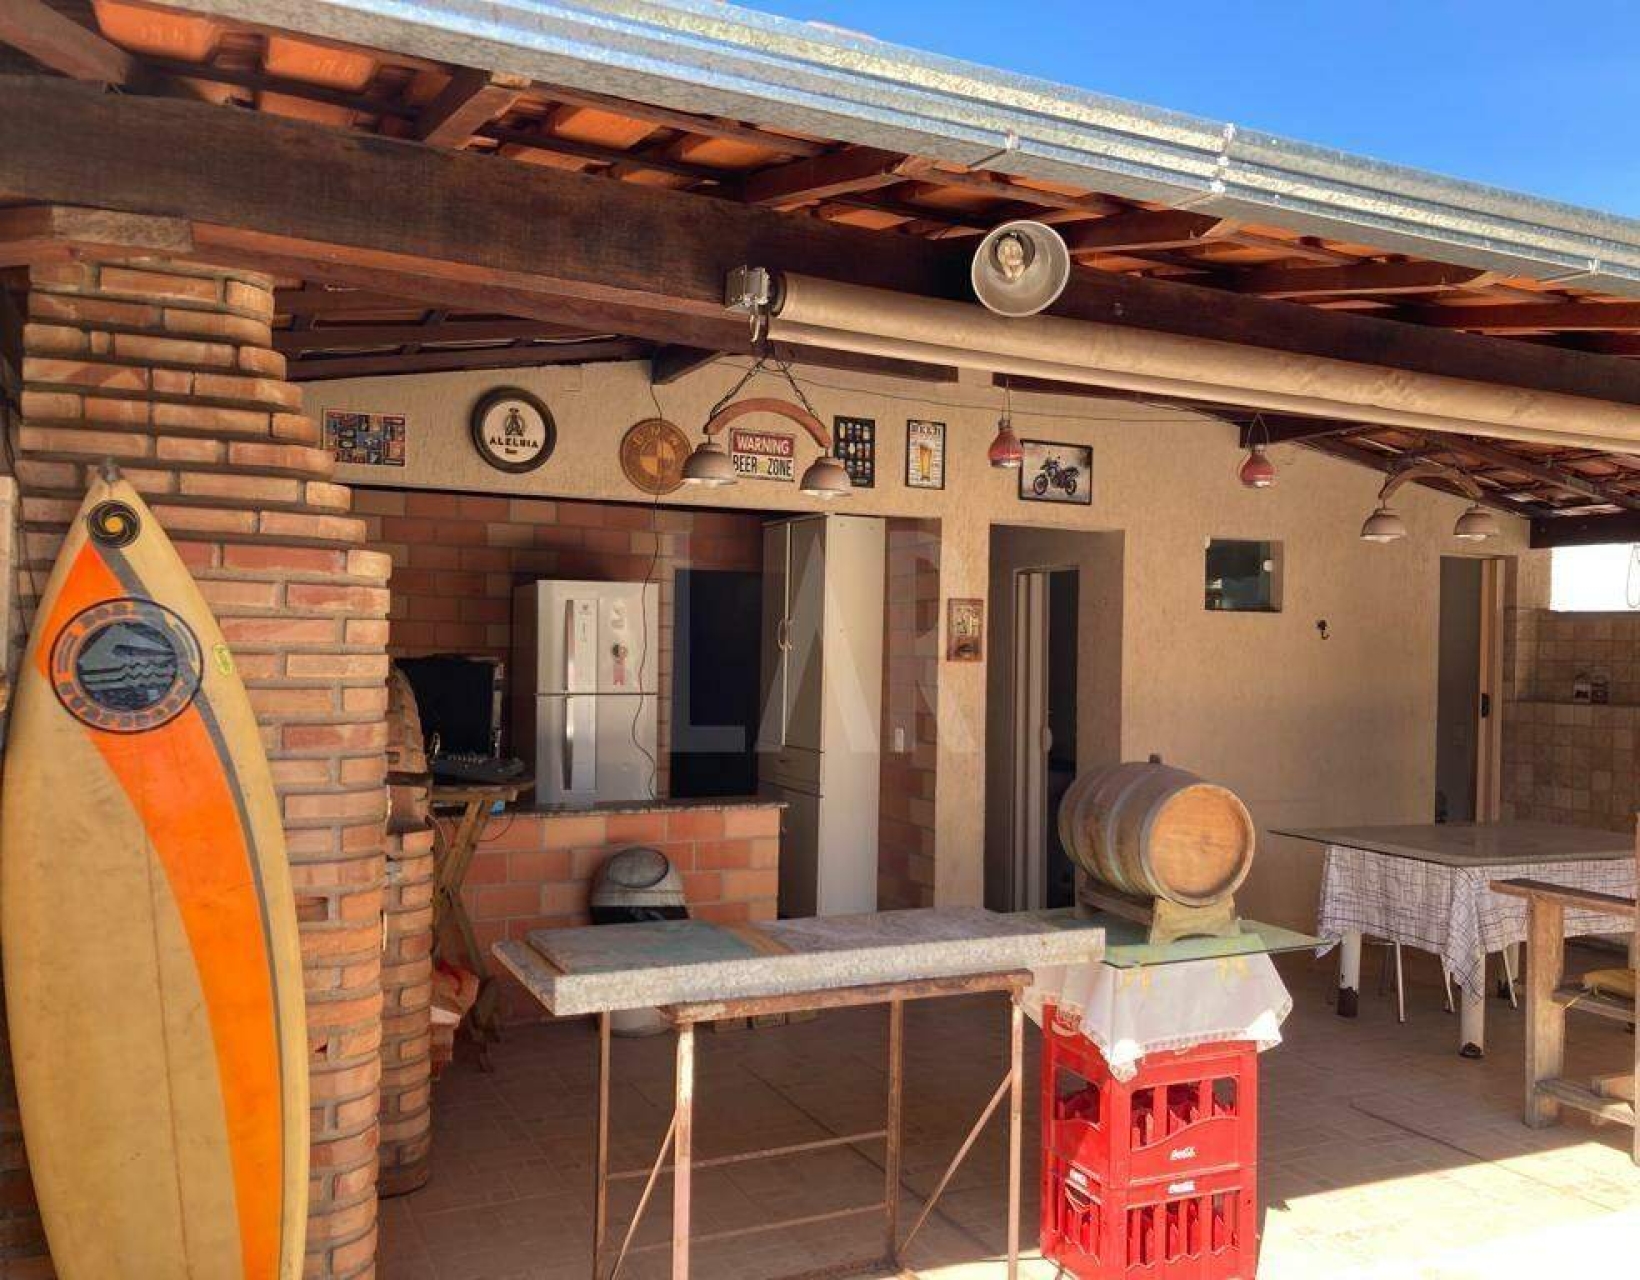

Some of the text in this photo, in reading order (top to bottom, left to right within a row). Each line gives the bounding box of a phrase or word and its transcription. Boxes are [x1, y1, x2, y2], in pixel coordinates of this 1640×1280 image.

[736, 435, 789, 454] WARNING
[733, 455, 792, 477] BEER ZONE
